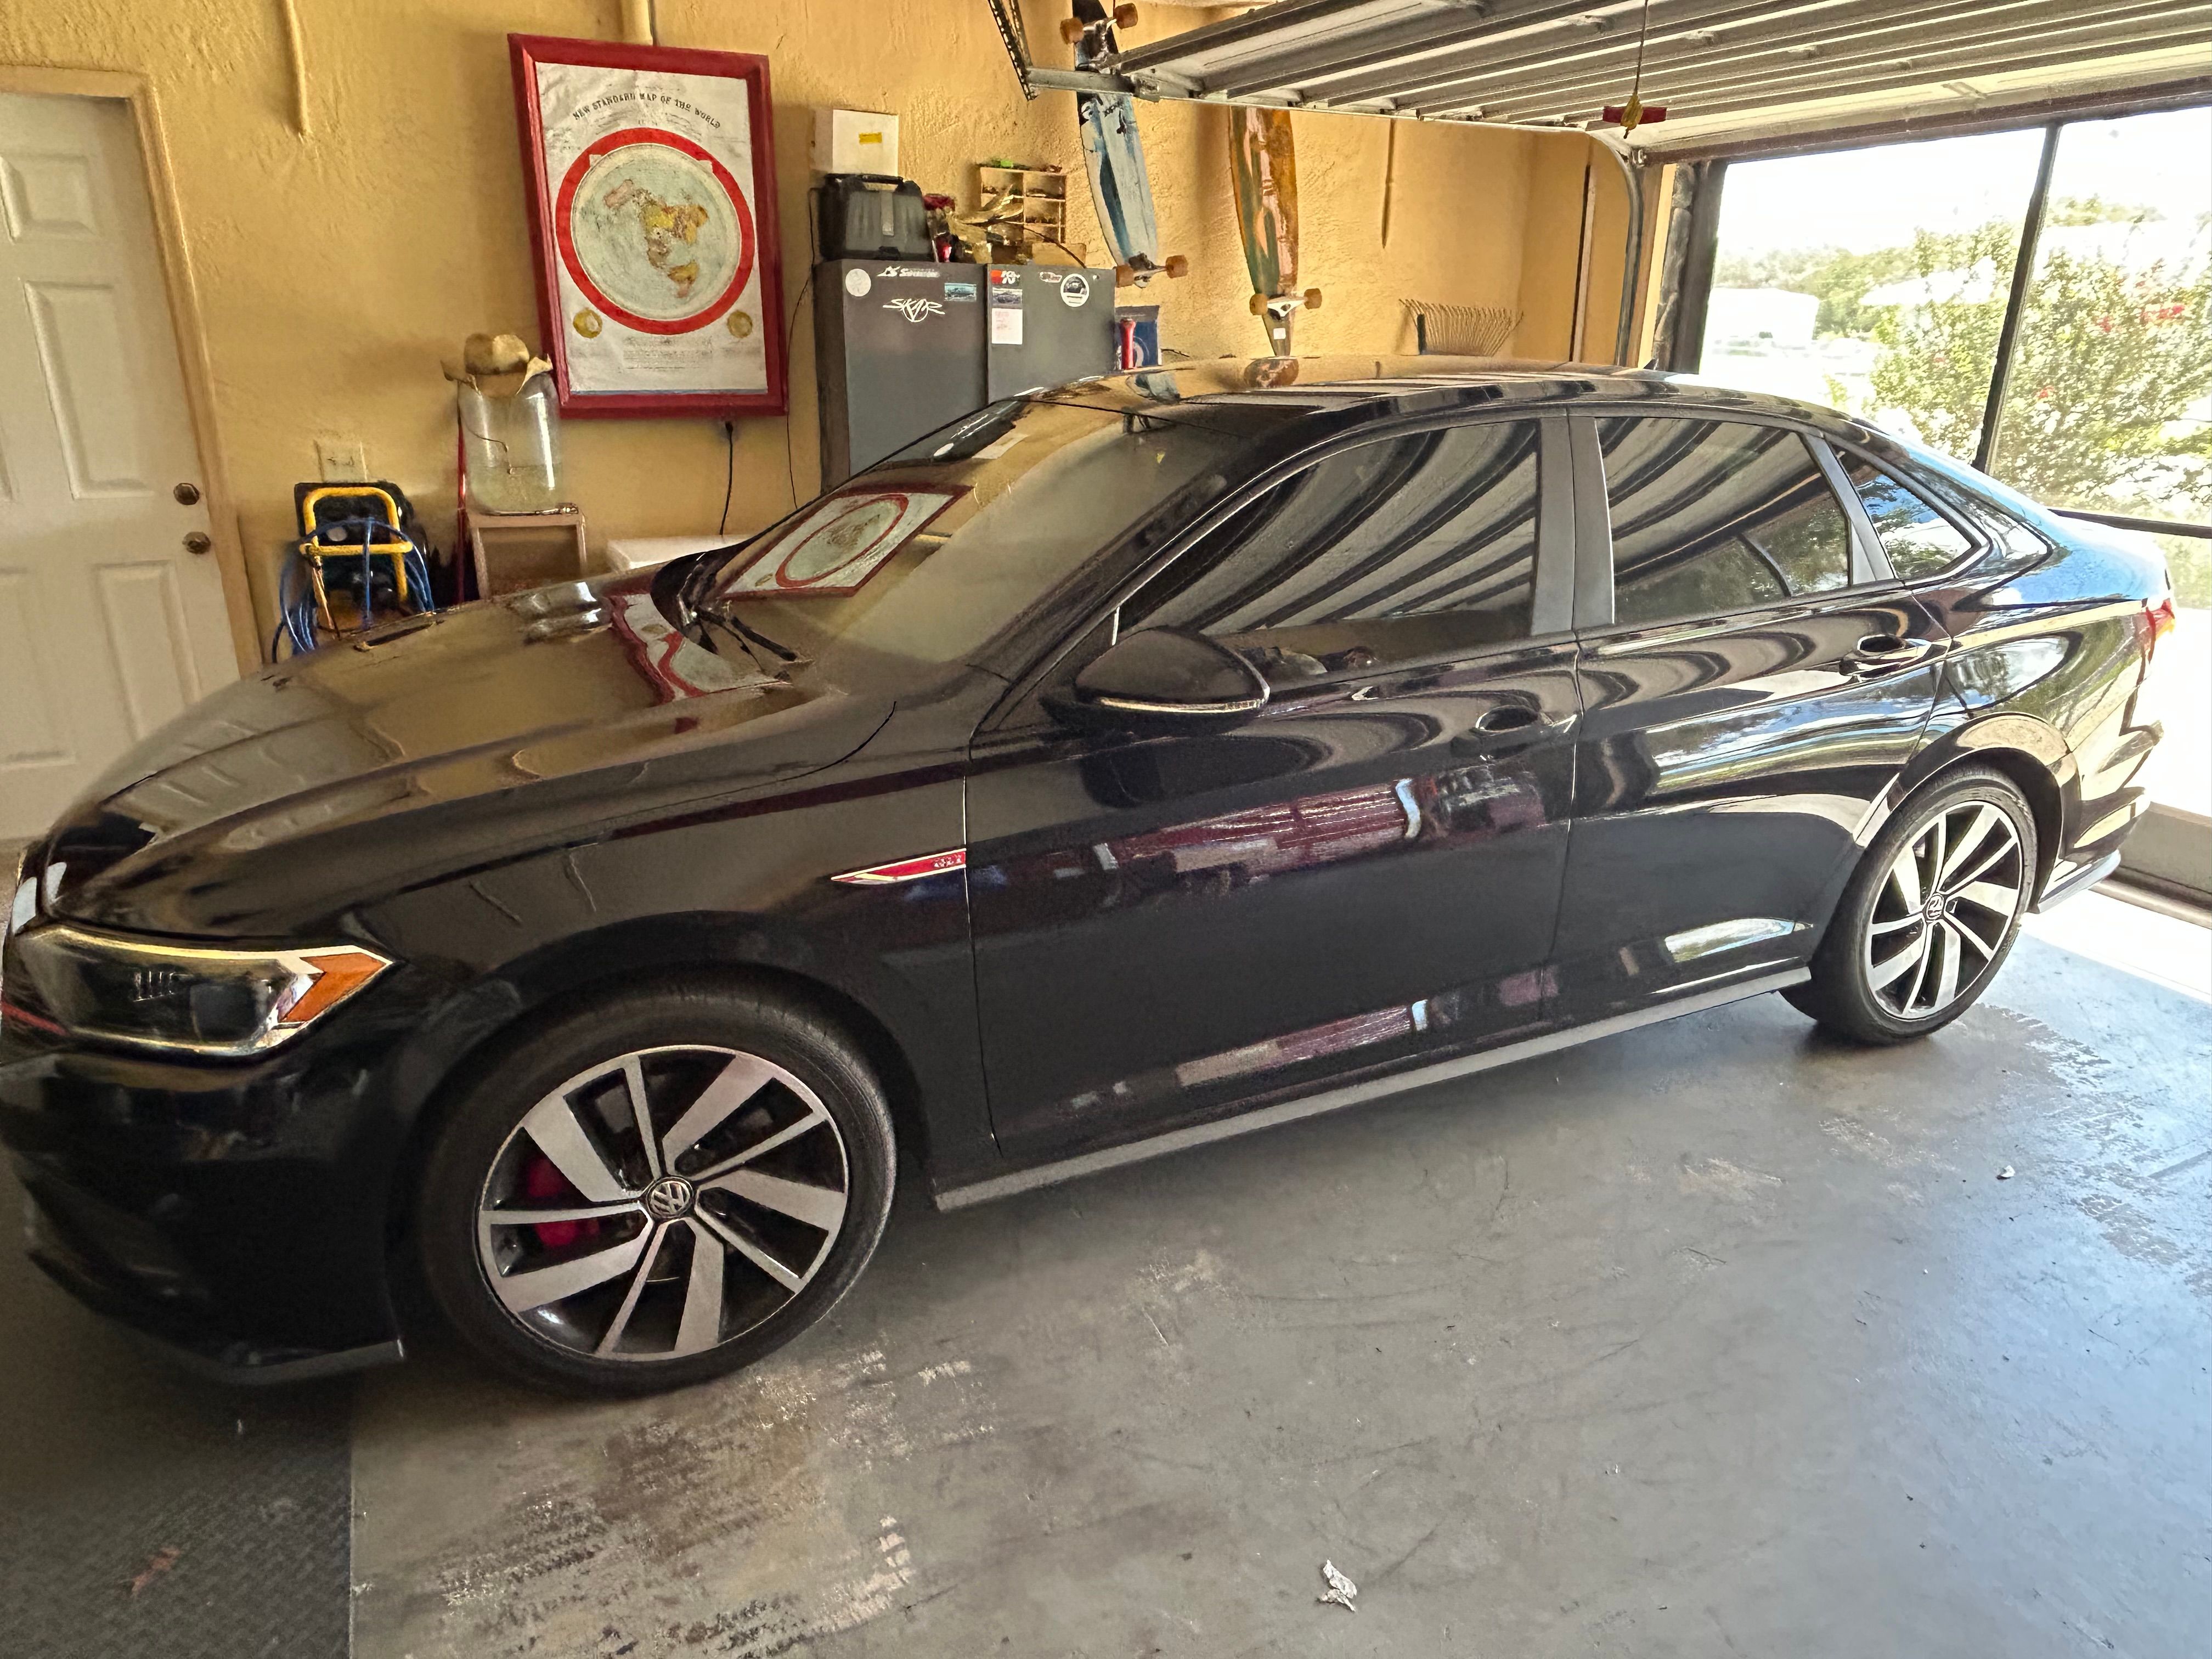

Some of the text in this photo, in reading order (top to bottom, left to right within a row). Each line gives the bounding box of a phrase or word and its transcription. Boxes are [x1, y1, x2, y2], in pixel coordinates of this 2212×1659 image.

[573, 105, 590, 120] NEW
[592, 92, 635, 110] STANDARD
[639, 93, 657, 101] MAP
[661, 95, 672, 104] OF
[695, 108, 720, 129] WORLD
